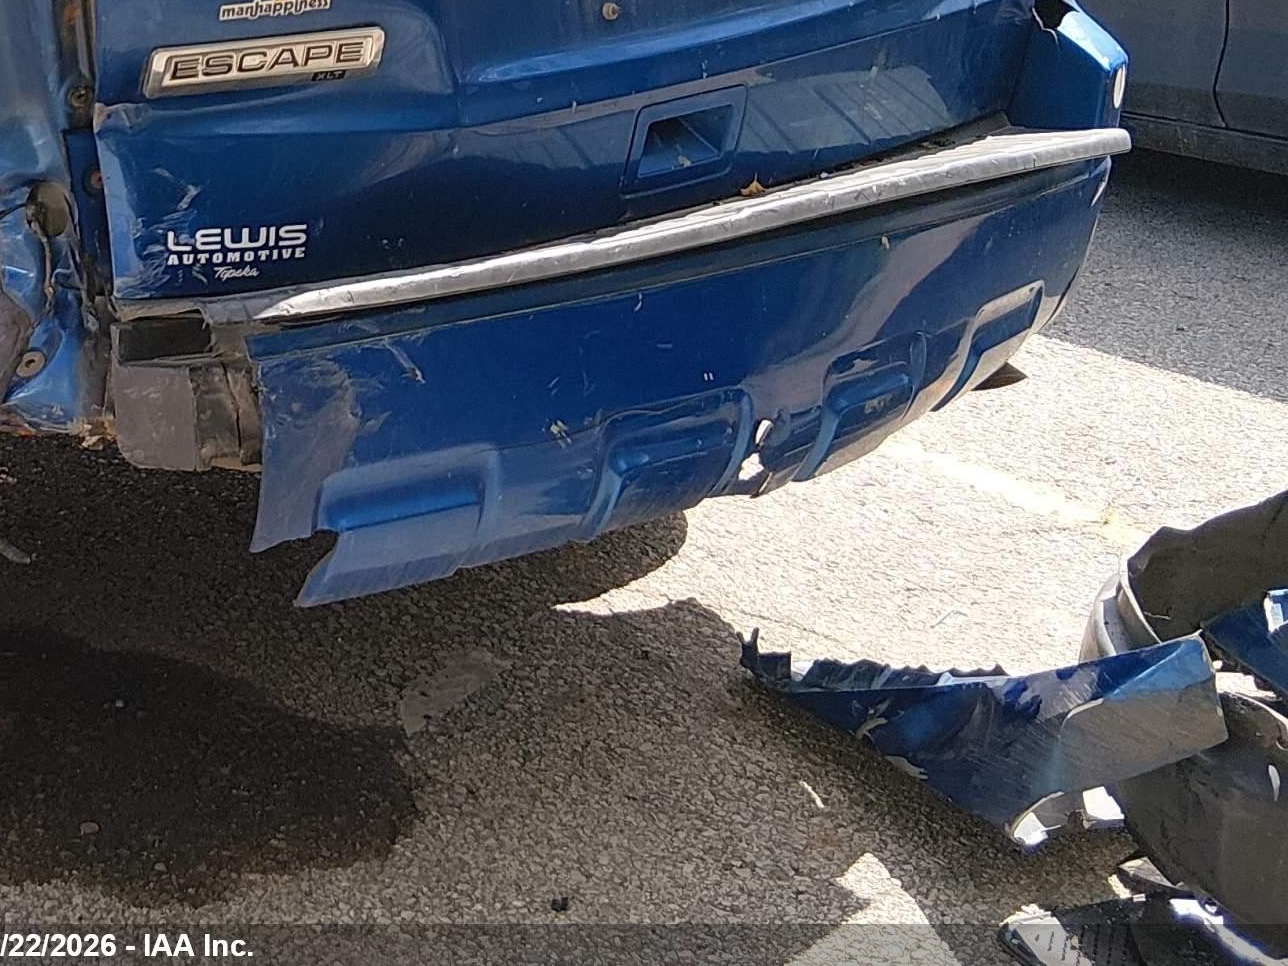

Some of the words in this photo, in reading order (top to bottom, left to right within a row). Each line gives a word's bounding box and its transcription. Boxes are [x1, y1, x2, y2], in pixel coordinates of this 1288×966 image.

[170, 40, 364, 80] ESCAPE
[315, 70, 342, 81] XLT
[167, 224, 307, 251] LEWIS
[167, 247, 306, 265] AUTOMOTIVE
[214, 266, 260, 281] Topeka
